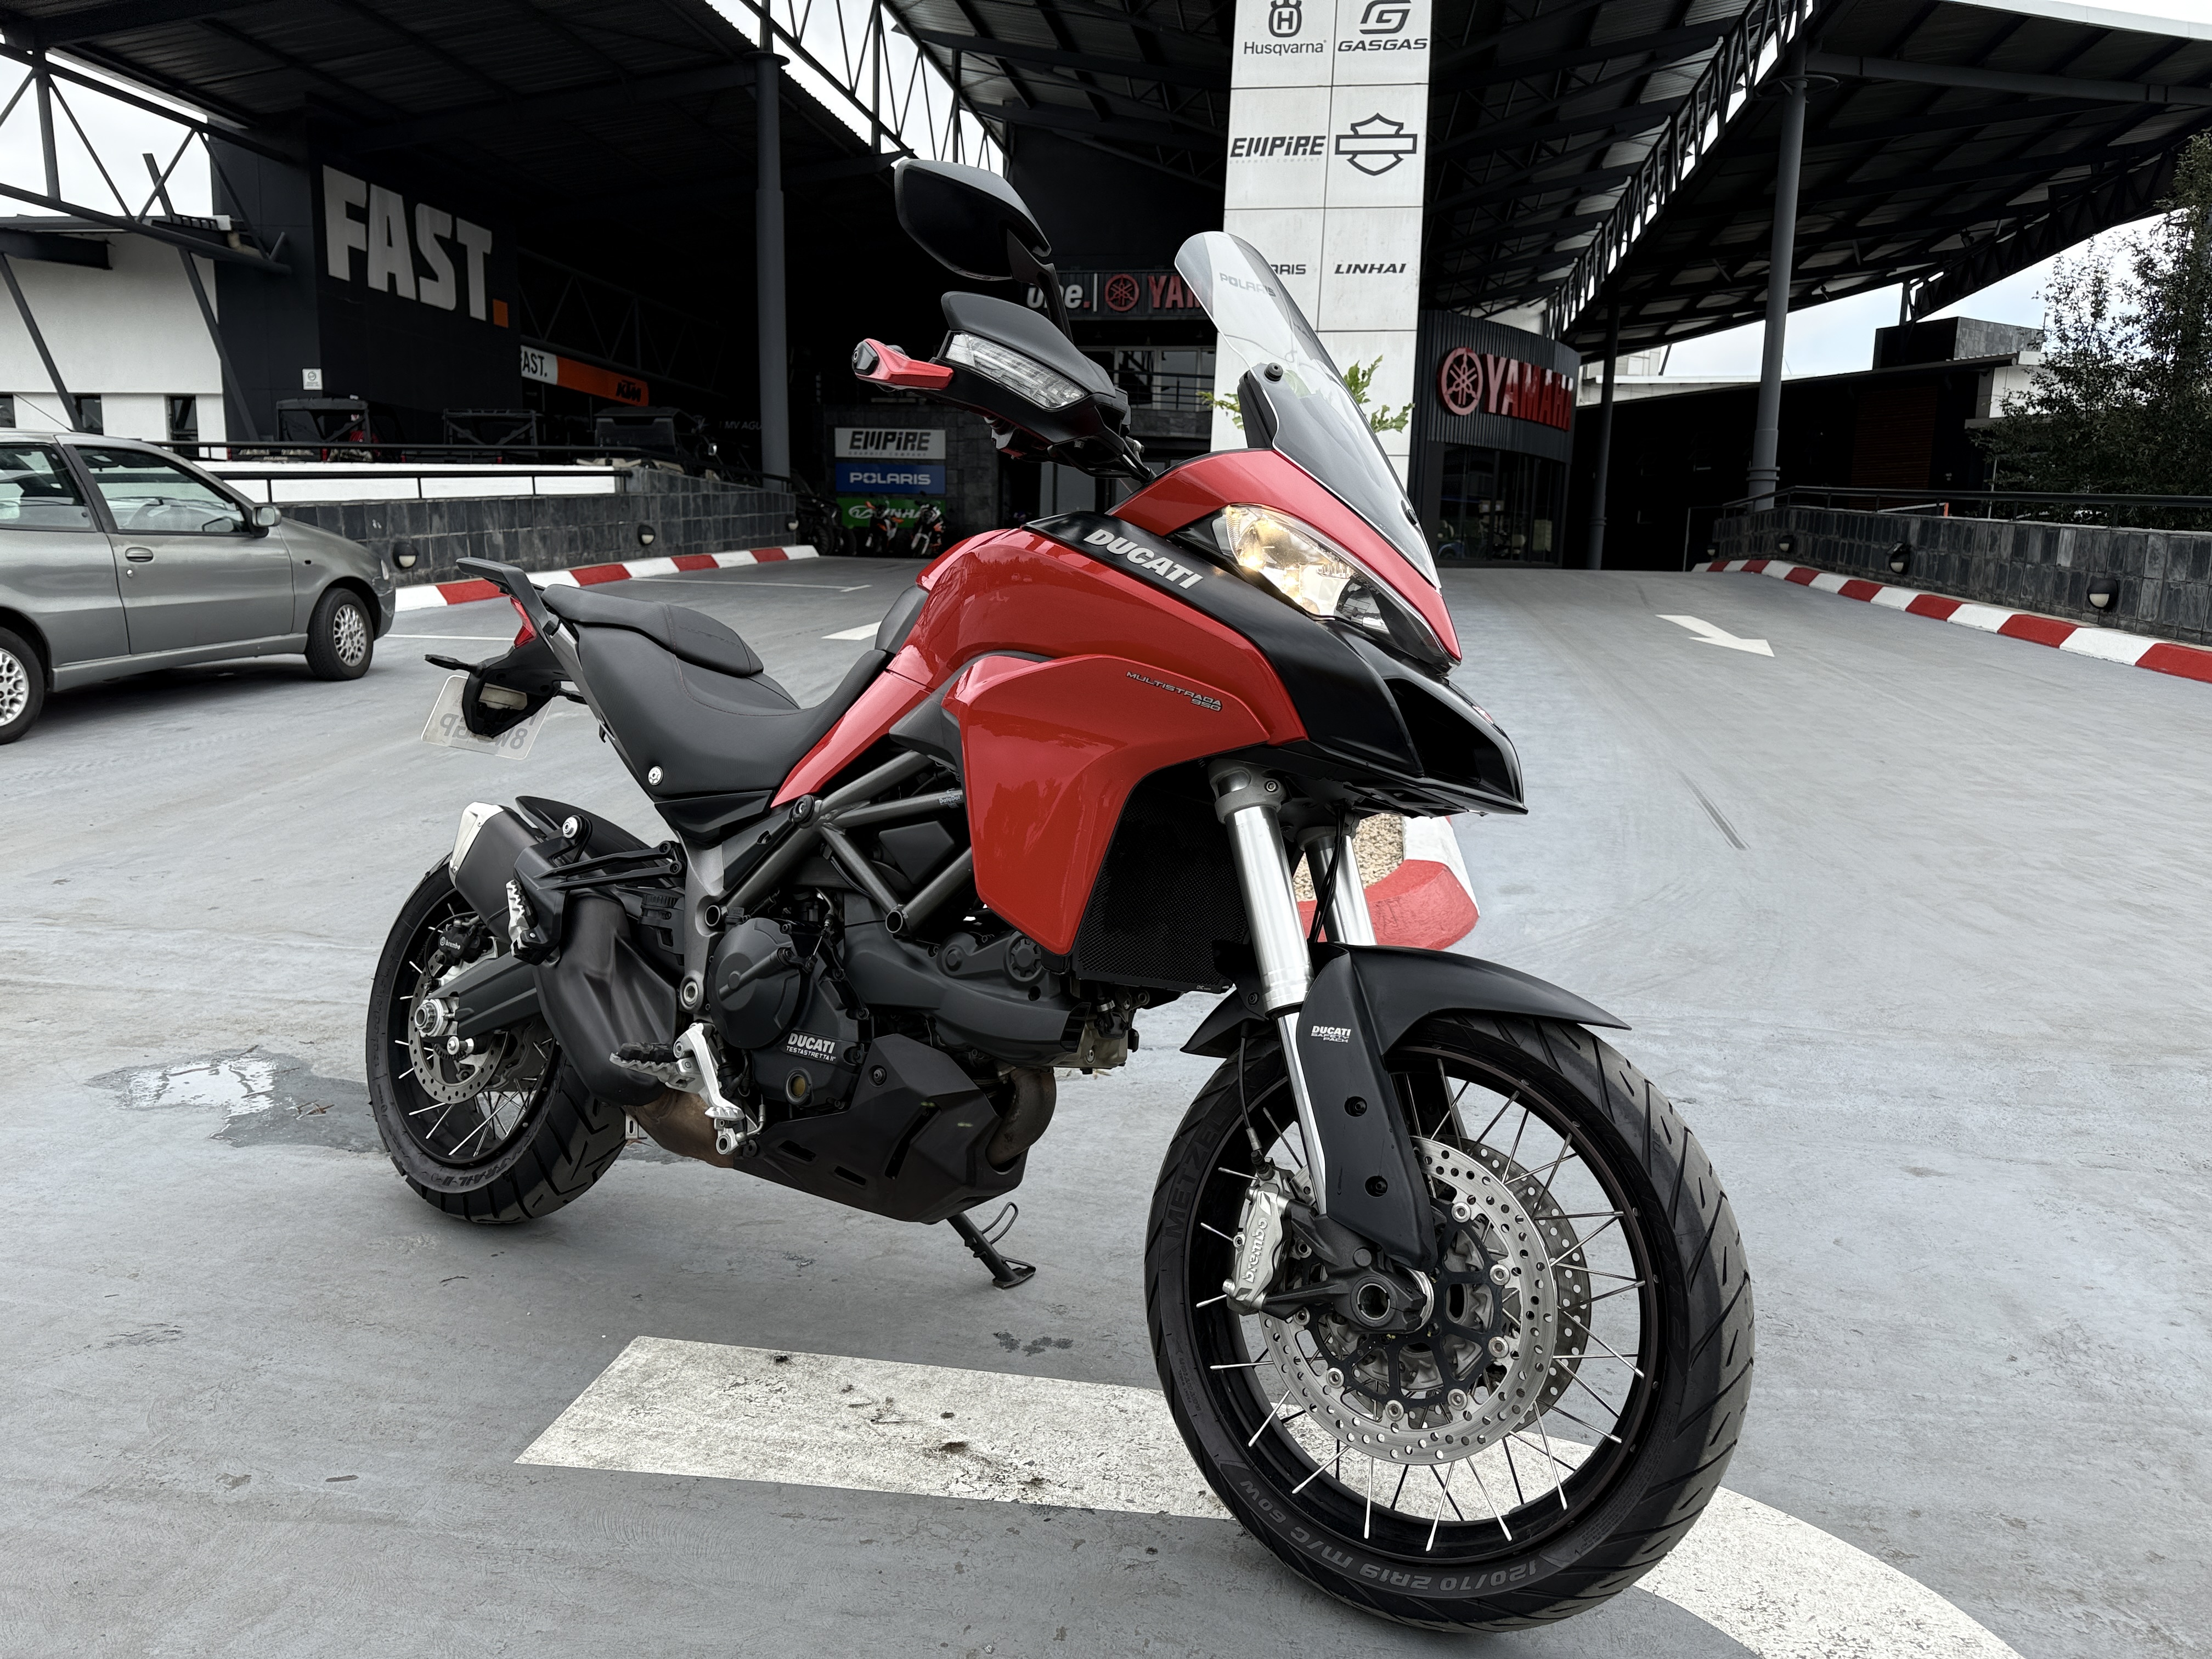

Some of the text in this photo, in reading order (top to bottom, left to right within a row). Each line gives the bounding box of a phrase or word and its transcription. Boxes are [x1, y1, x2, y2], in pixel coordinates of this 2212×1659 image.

[1243, 40, 1324, 56] Husqvarna
[1338, 38, 1428, 52] GASGAS
[322, 163, 509, 329] FAST.
[1334, 263, 1407, 274] LINHAI
[1026, 283, 1092, 309] oe.
[520, 351, 547, 378] AST.
[616, 380, 642, 402] KTM
[1482, 353, 1574, 432] YAMAHA
[740, 420, 761, 430] AGU
[849, 471, 932, 486] POLARIS
[1083, 529, 1204, 590] DUCATI
[1126, 671, 1222, 707] MULTISTRADA
[1190, 698, 1222, 712] 950
[1311, 1025, 1351, 1036] DUCATI
[786, 1045, 830, 1061] TESTASTRETTA
[787, 1032, 836, 1054] DUCATI
[1241, 1217, 1268, 1284] brembo
[1239, 1481, 1286, 1523] 60W
[1359, 1562, 1432, 1590] ZR19
[1439, 1559, 1536, 1591] 120/70
